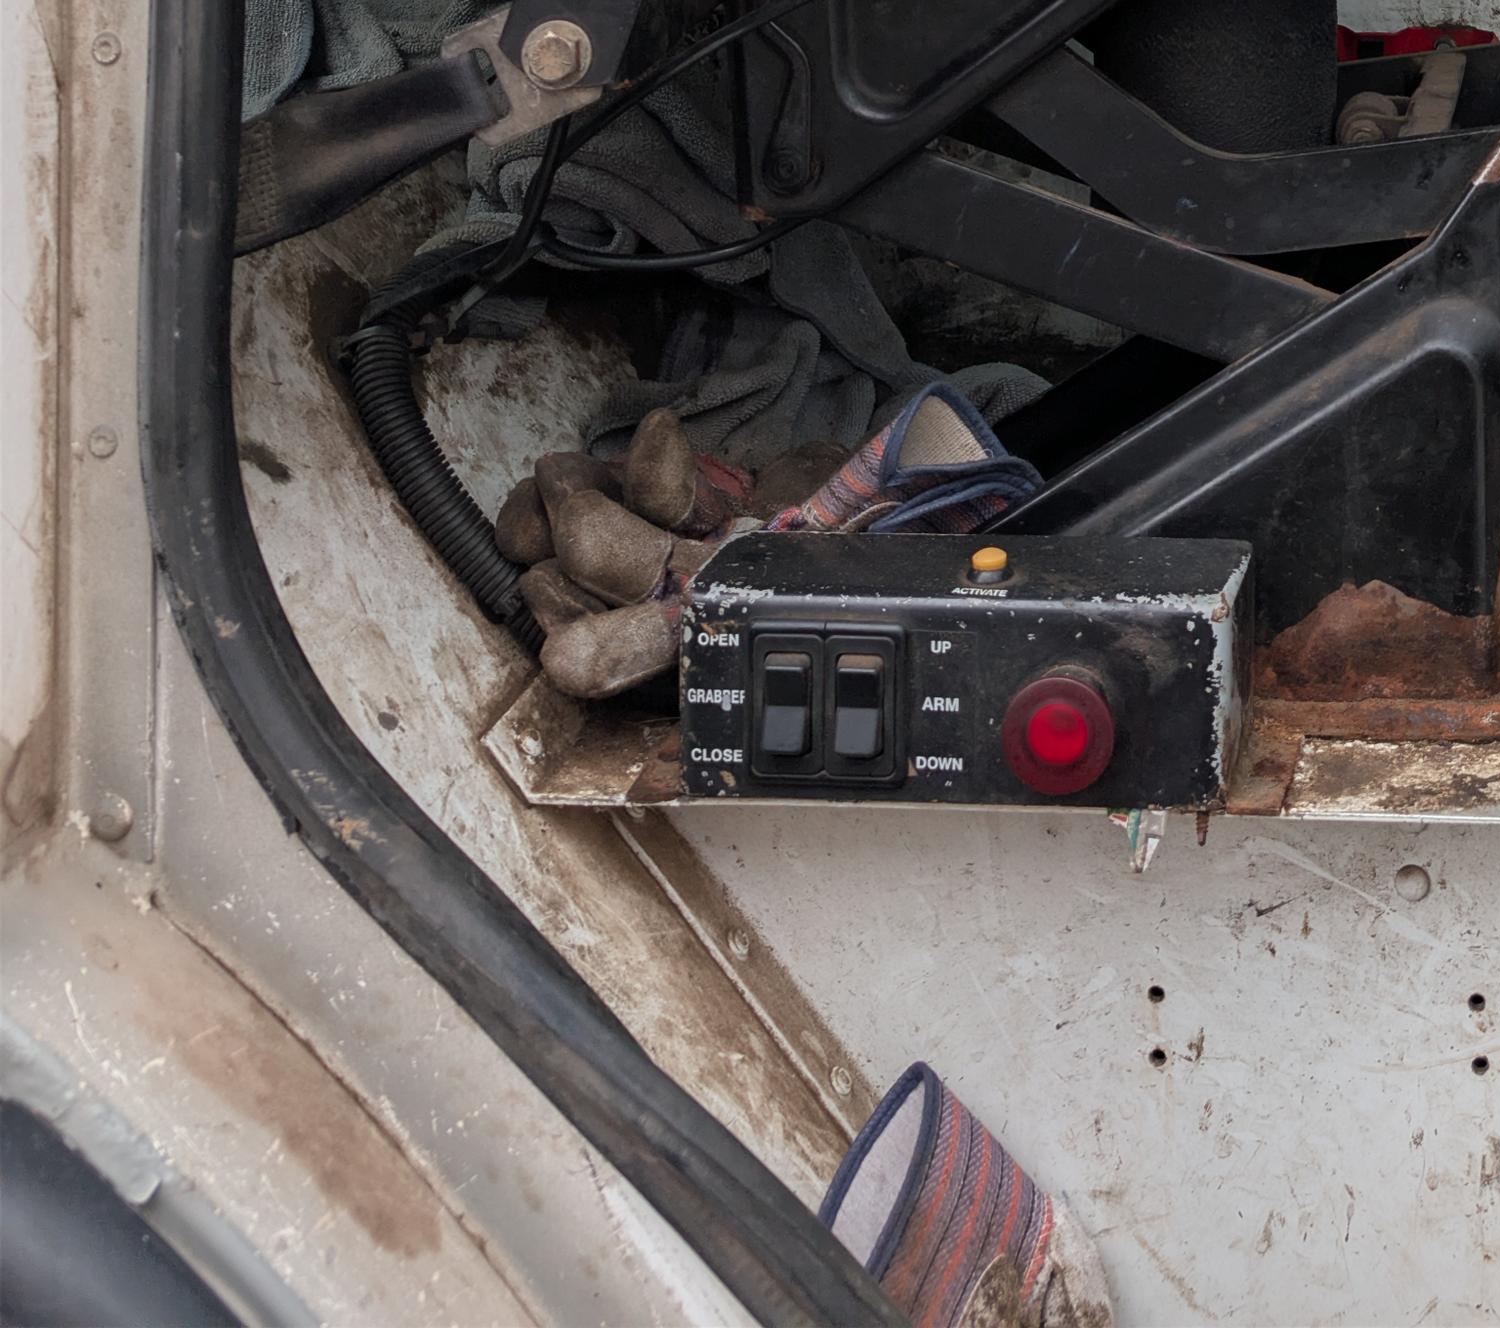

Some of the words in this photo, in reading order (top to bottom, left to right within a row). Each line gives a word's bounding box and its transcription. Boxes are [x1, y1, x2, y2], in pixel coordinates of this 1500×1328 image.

[951, 587, 1009, 598] ACTIVATE
[697, 632, 740, 646] OPEN
[930, 640, 952, 654] UP
[922, 697, 960, 712] ARM
[690, 747, 743, 762] CLOSE
[915, 755, 964, 771] DOWN
